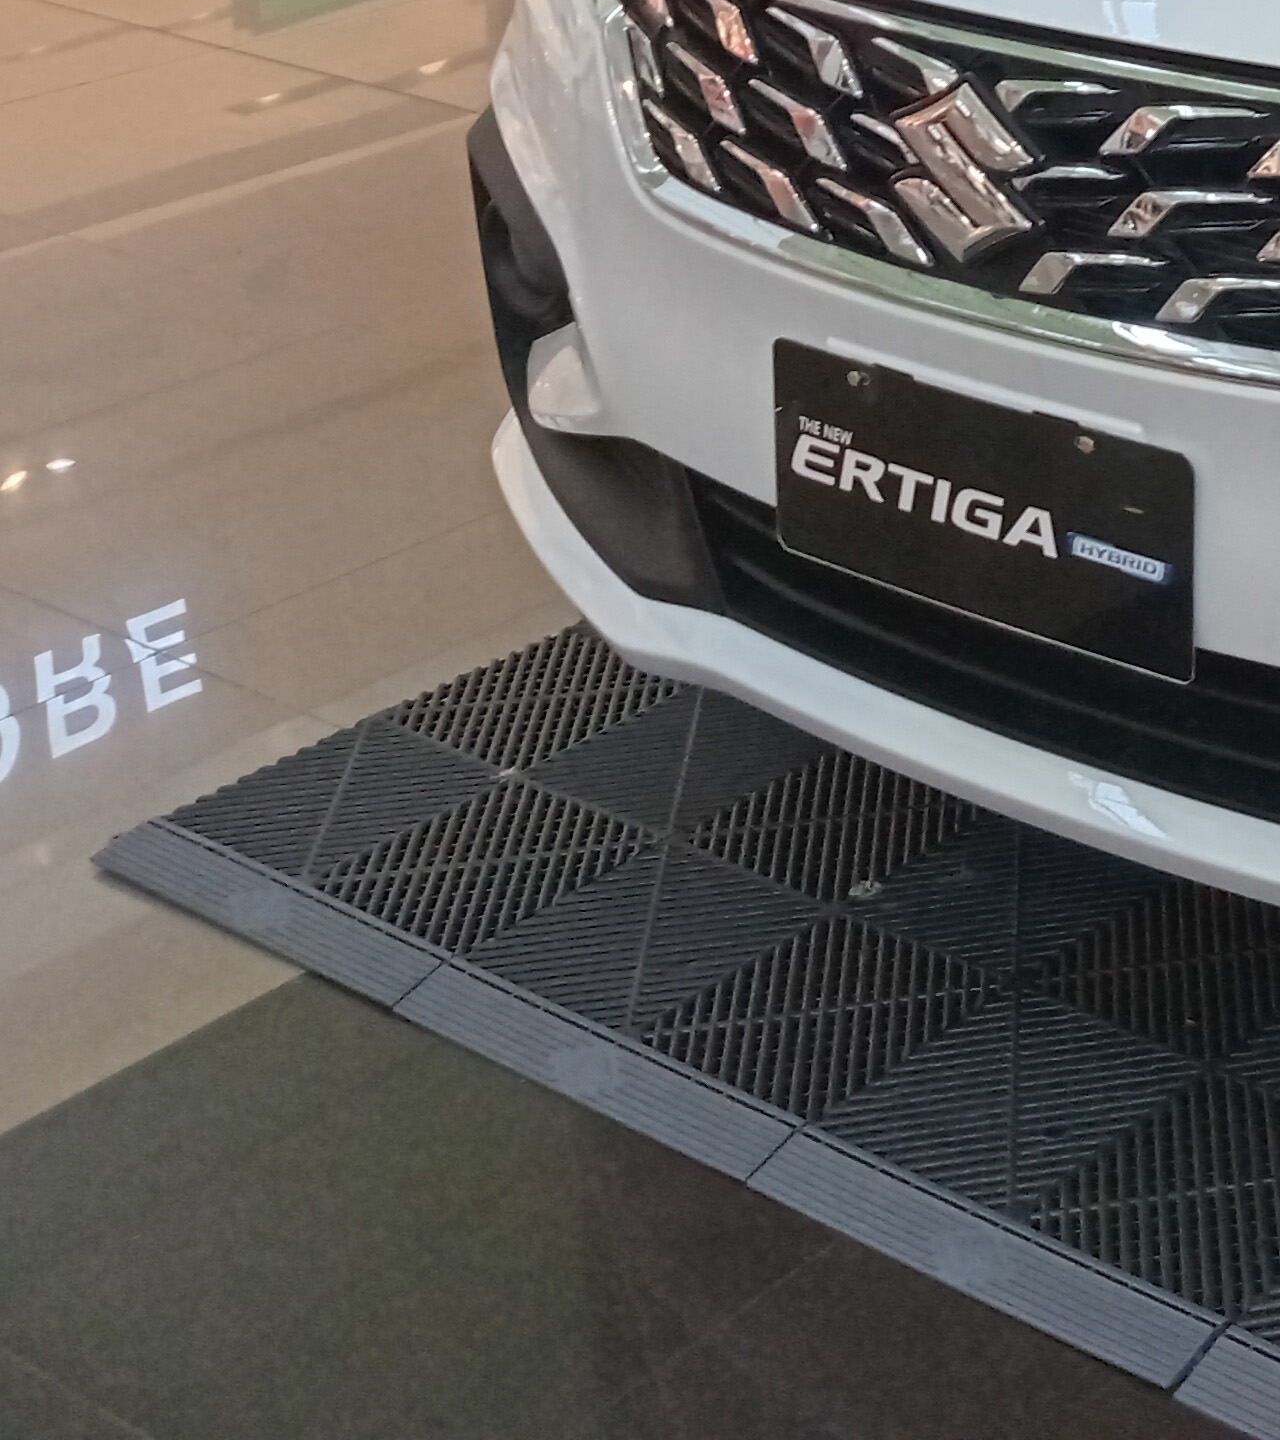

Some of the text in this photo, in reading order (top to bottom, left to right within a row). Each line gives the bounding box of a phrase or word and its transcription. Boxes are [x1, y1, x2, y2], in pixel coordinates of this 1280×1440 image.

[799, 415, 854, 446] THE NEW
[791, 433, 1059, 559] ERTIGA
[1079, 542, 1158, 575] HYBRID
